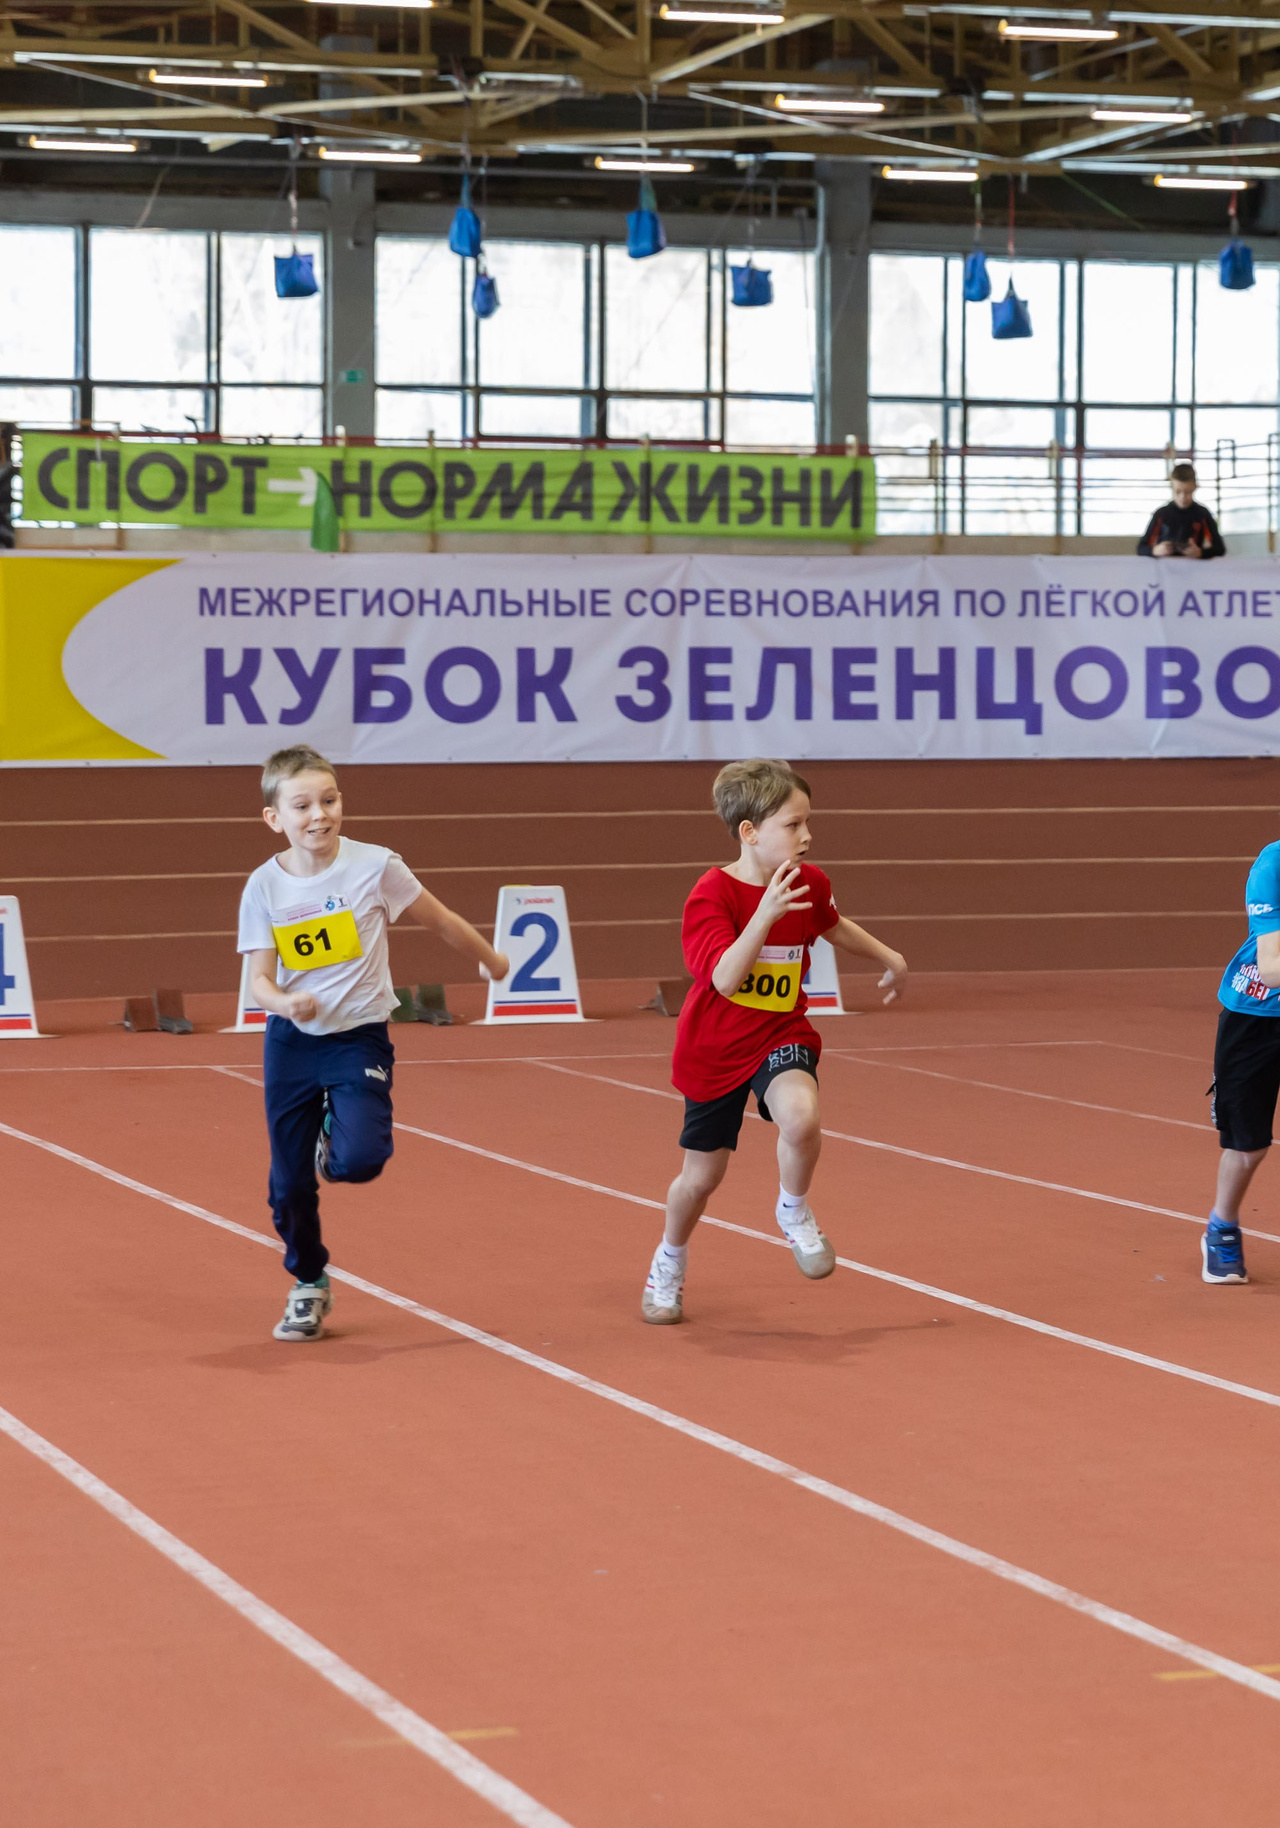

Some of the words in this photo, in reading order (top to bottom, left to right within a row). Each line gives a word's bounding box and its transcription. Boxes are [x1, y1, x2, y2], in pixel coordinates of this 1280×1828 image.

[38, 447, 268, 515] СПОРТ
[331, 459, 594, 520] НОРМА
[608, 461, 863, 529] ЖИЗНИ
[198, 587, 611, 617] МЕЖРЕГИОНАЛЬНЫЕ
[624, 588, 939, 617] СОРЕВНОВАНИЯ
[954, 589, 1006, 617] ПО
[1018, 584, 1166, 617] ЛЁГКОЙ
[204, 646, 578, 725] КУБОК
[293, 928, 332, 957] 61
[509, 912, 559, 992] 2
